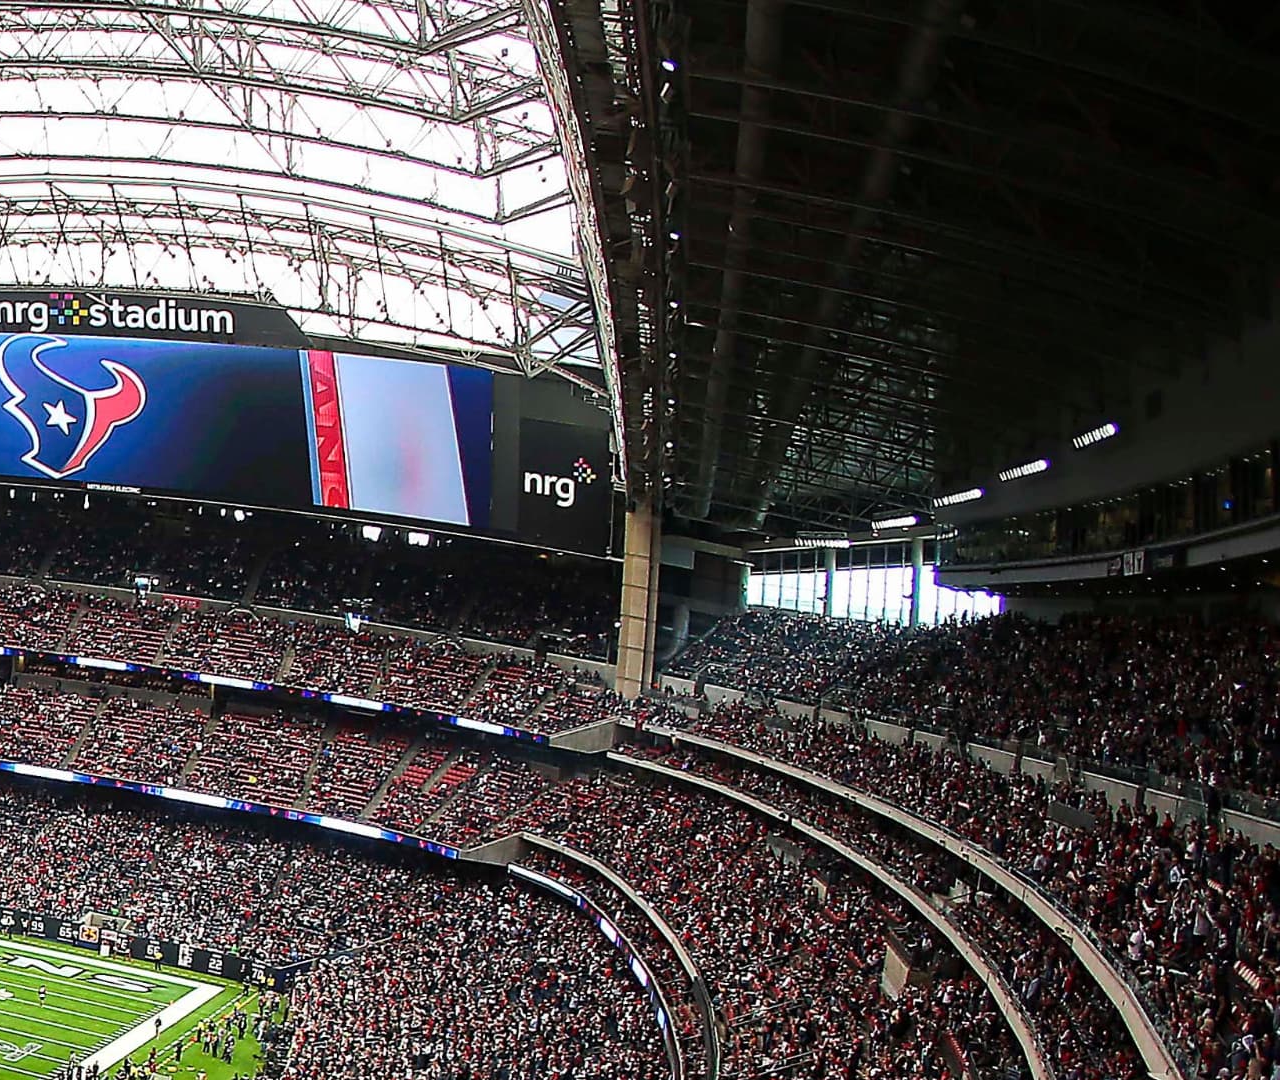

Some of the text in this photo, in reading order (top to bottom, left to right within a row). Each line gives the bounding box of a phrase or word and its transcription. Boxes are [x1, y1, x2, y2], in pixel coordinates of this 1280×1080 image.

[89, 298, 234, 334] stadium
[524, 471, 575, 507] nrg
[30, 921, 44, 933] 99
[59, 926, 73, 938] 65
[82, 927, 97, 940] 25
[208, 959, 223, 971] 22
